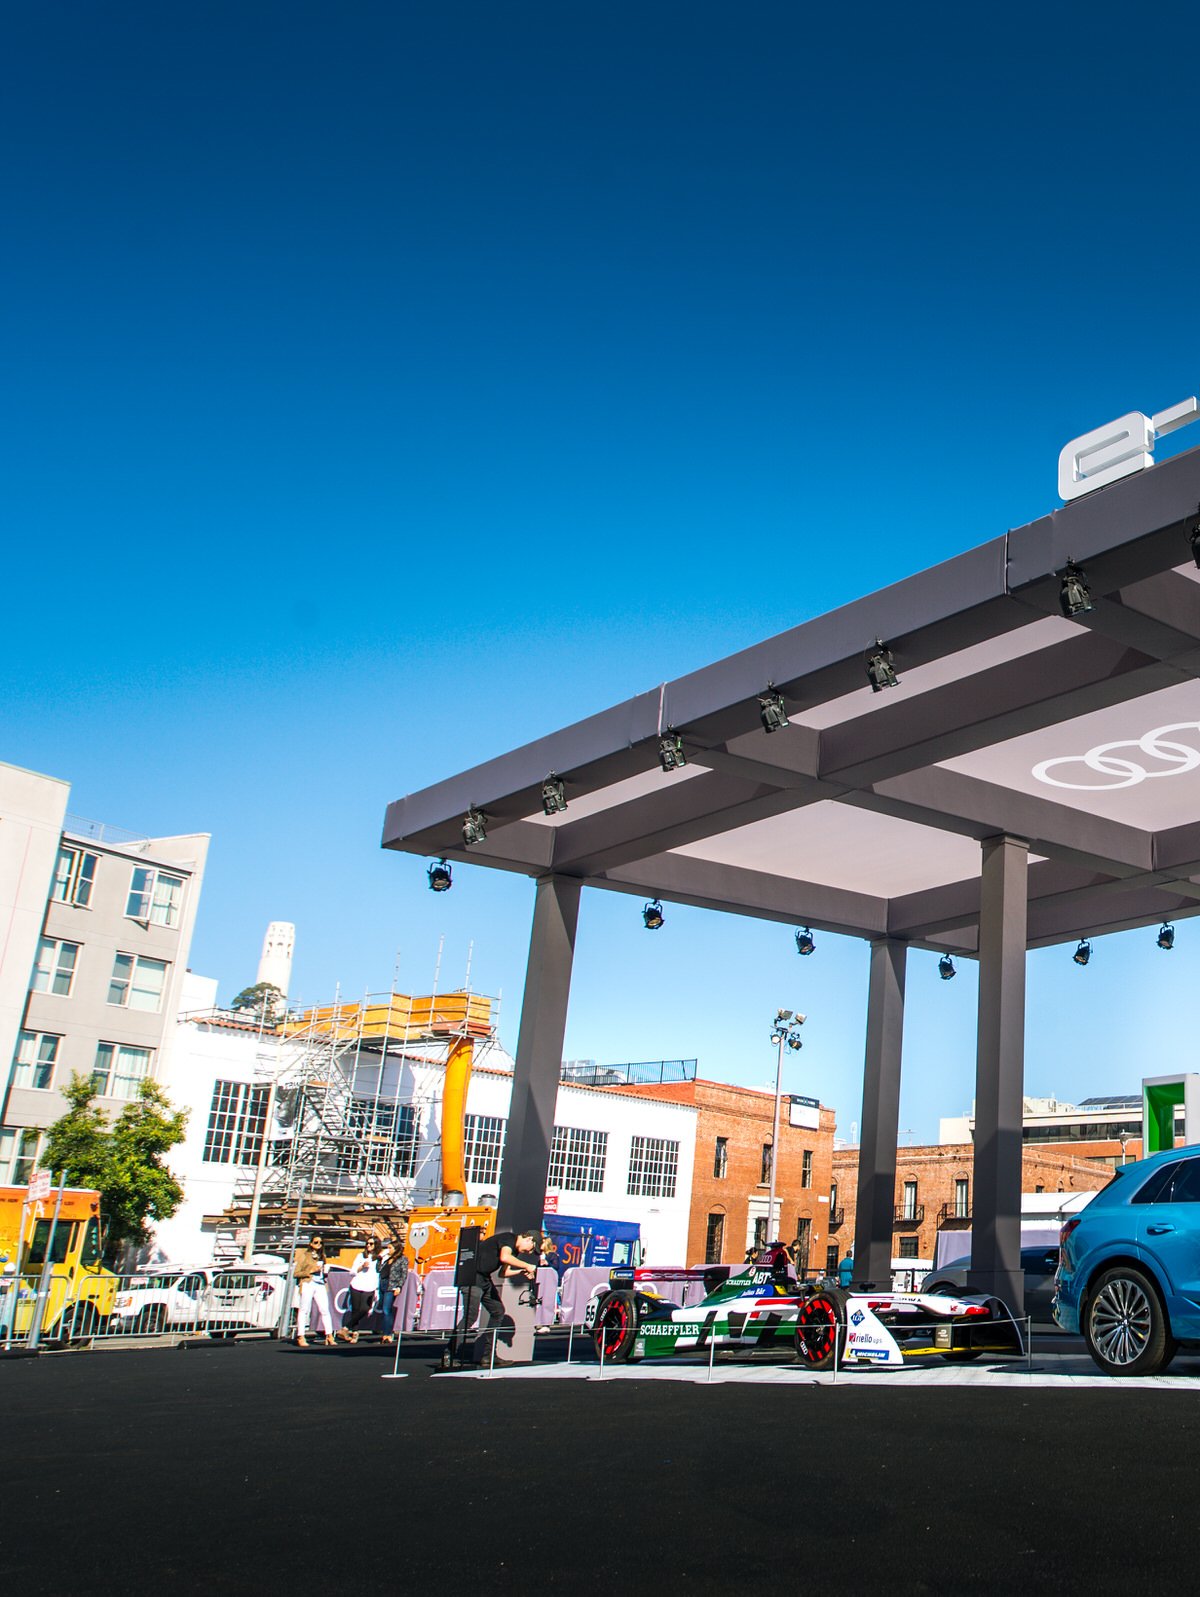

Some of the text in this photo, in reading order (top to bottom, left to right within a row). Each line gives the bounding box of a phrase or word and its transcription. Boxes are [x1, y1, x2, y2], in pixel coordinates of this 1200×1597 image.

[752, 1272, 772, 1285] ABT
[585, 1304, 595, 1321] 66
[640, 1324, 700, 1336] SCHAEFFLER
